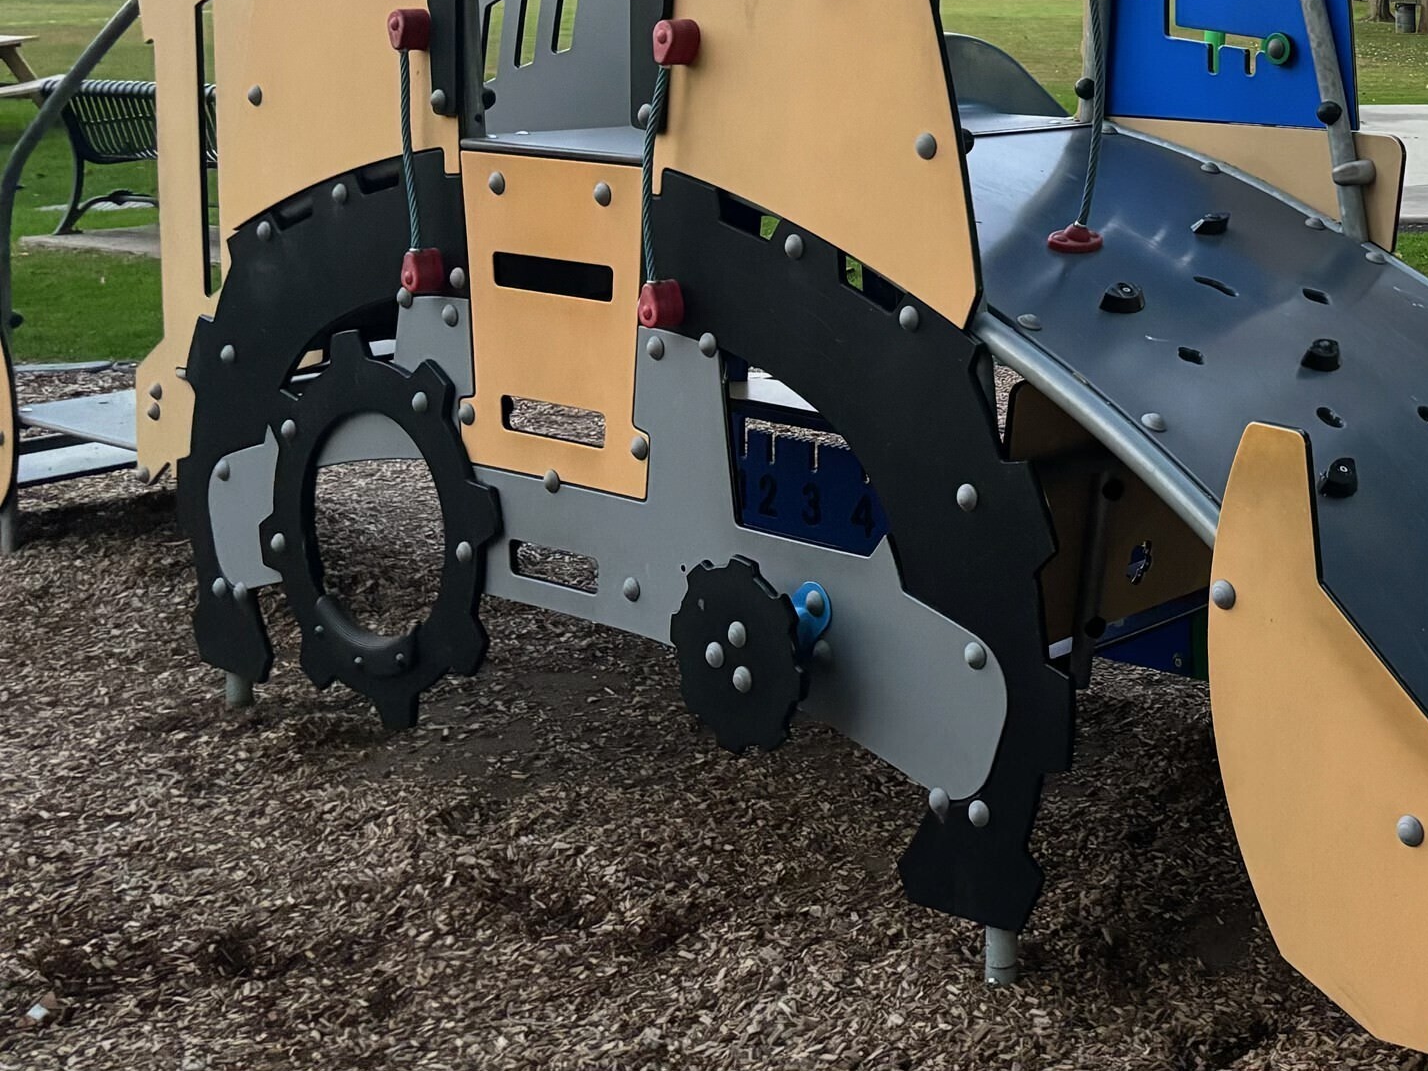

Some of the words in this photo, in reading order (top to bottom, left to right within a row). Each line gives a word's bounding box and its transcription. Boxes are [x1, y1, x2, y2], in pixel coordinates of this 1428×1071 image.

[759, 475, 778, 516] 2
[802, 482, 822, 526] 3
[852, 495, 876, 538] 4
